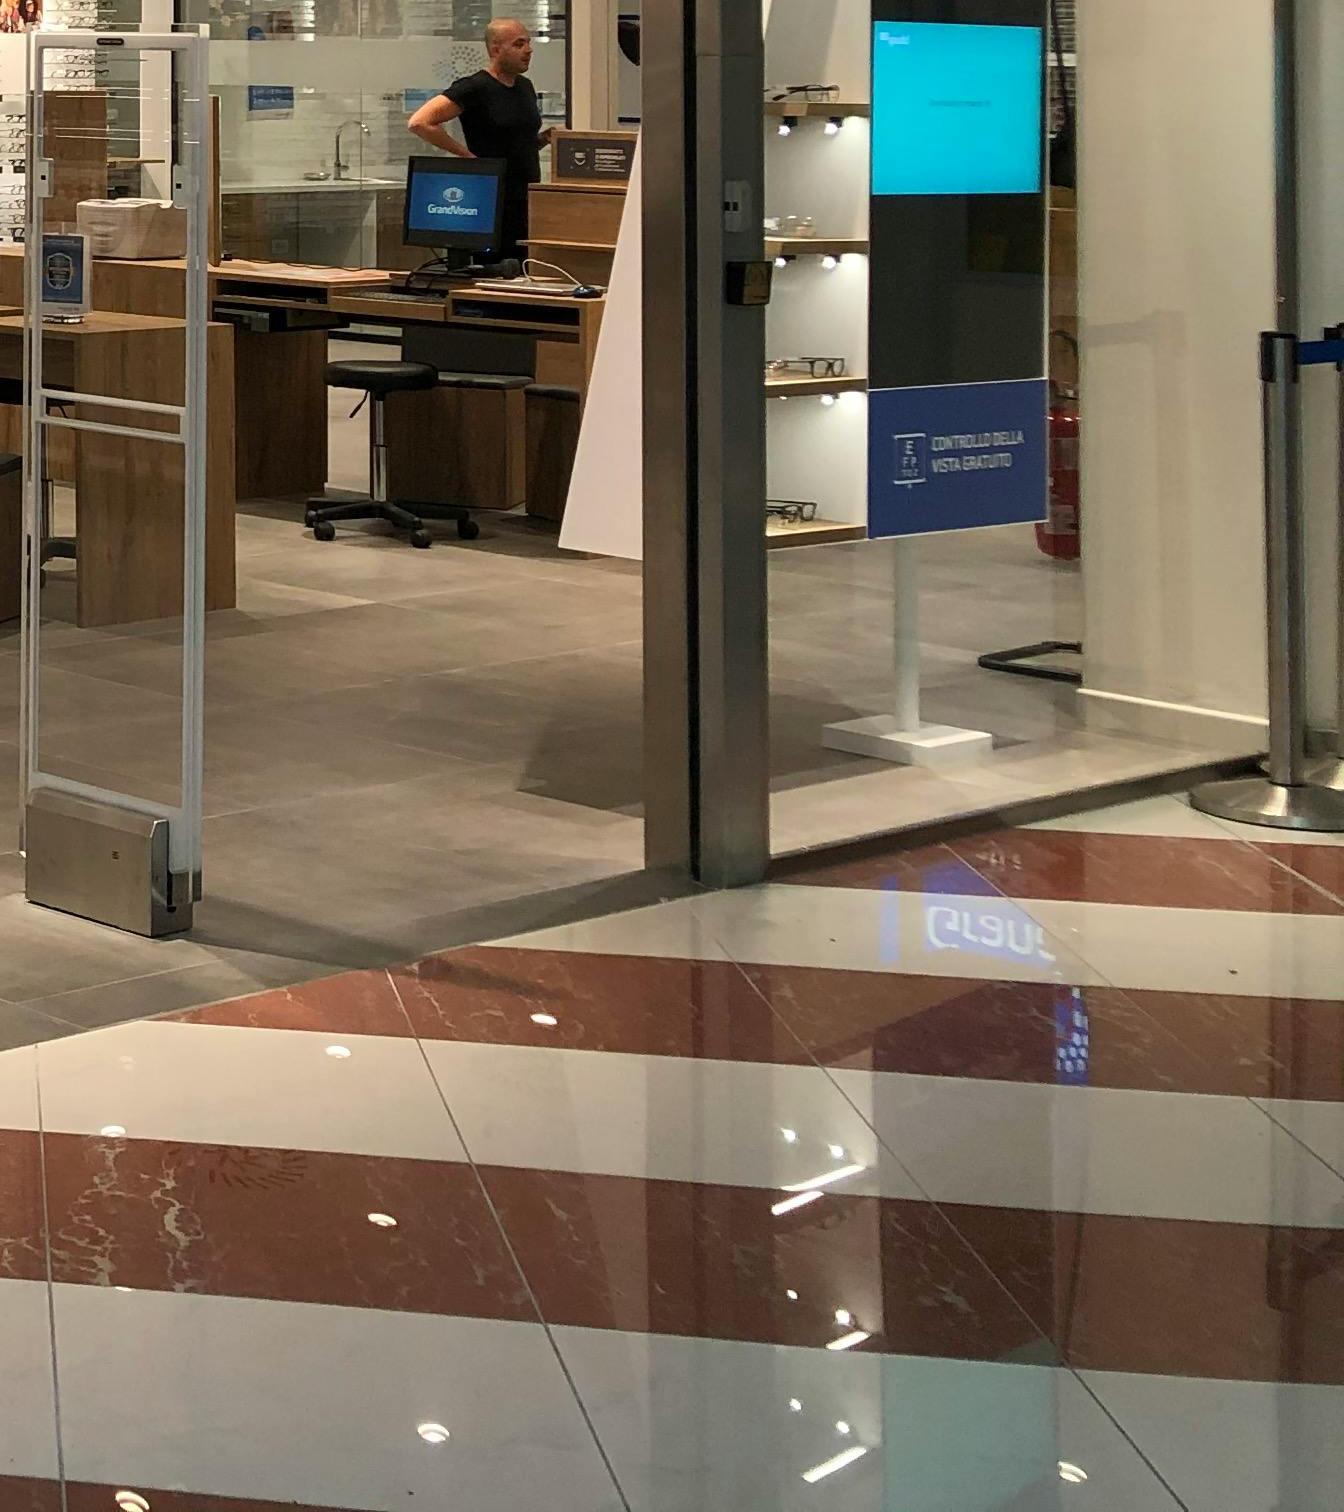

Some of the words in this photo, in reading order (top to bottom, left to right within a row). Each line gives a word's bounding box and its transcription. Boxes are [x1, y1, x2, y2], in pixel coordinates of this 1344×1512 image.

[427, 203, 478, 217] GrandVision
[905, 440, 915, 455] E
[931, 432, 991, 452] CONTROLLO
[992, 430, 1025, 447] DELLA
[930, 457, 962, 473] VISTA
[962, 452, 1013, 471] GRATUITO
